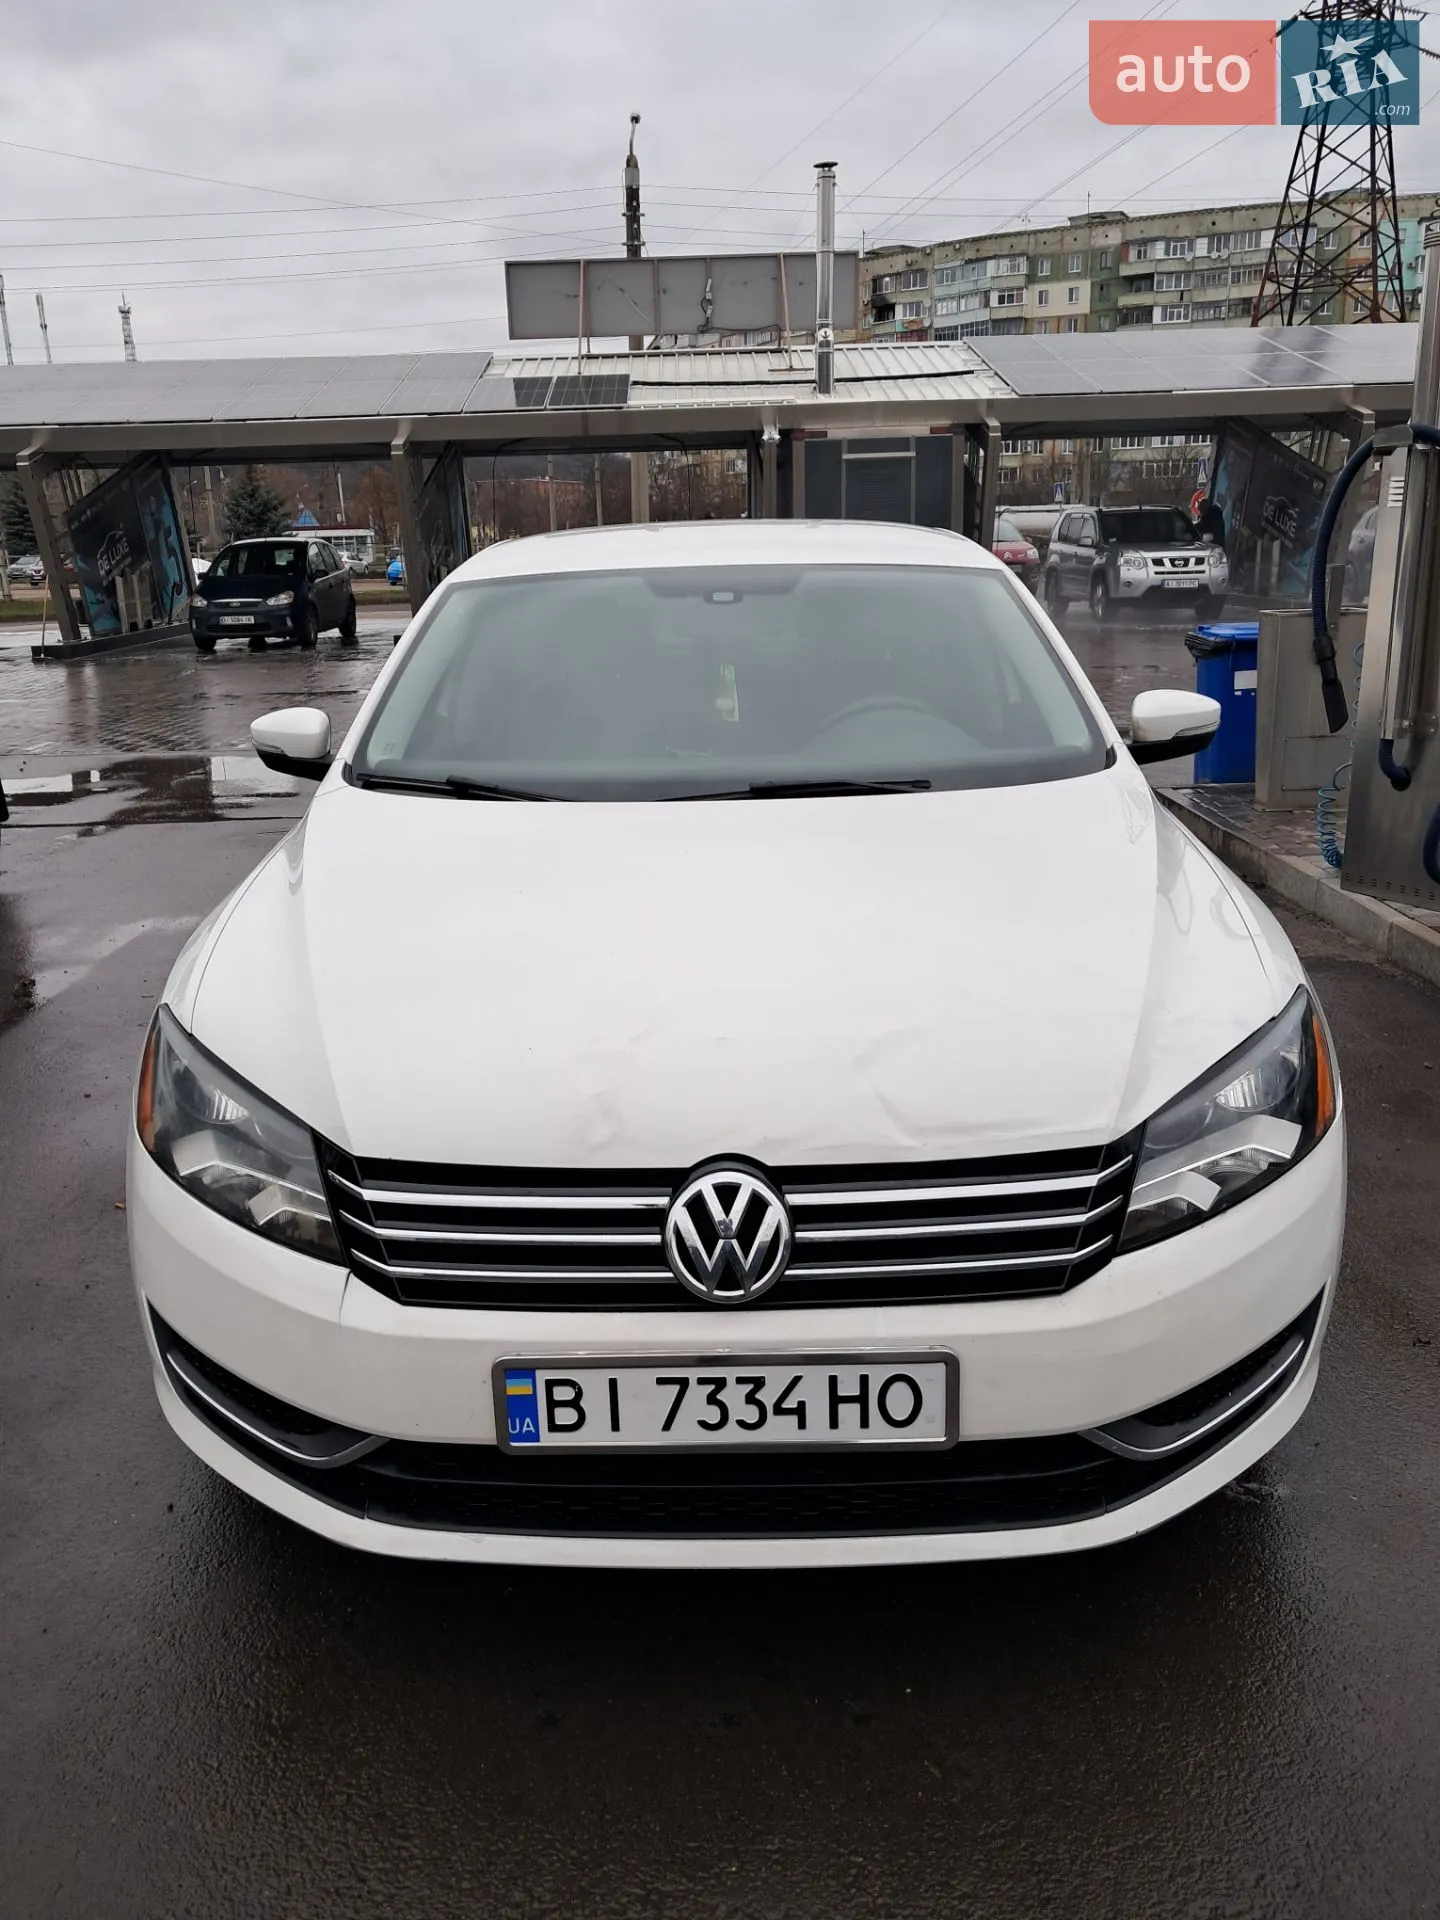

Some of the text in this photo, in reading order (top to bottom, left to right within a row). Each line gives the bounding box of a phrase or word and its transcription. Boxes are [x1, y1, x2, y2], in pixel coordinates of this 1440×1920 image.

[97, 555, 110, 577] DE
[108, 536, 130, 566] LUXE
[508, 1373, 924, 1434] UA BI 7334 HO
